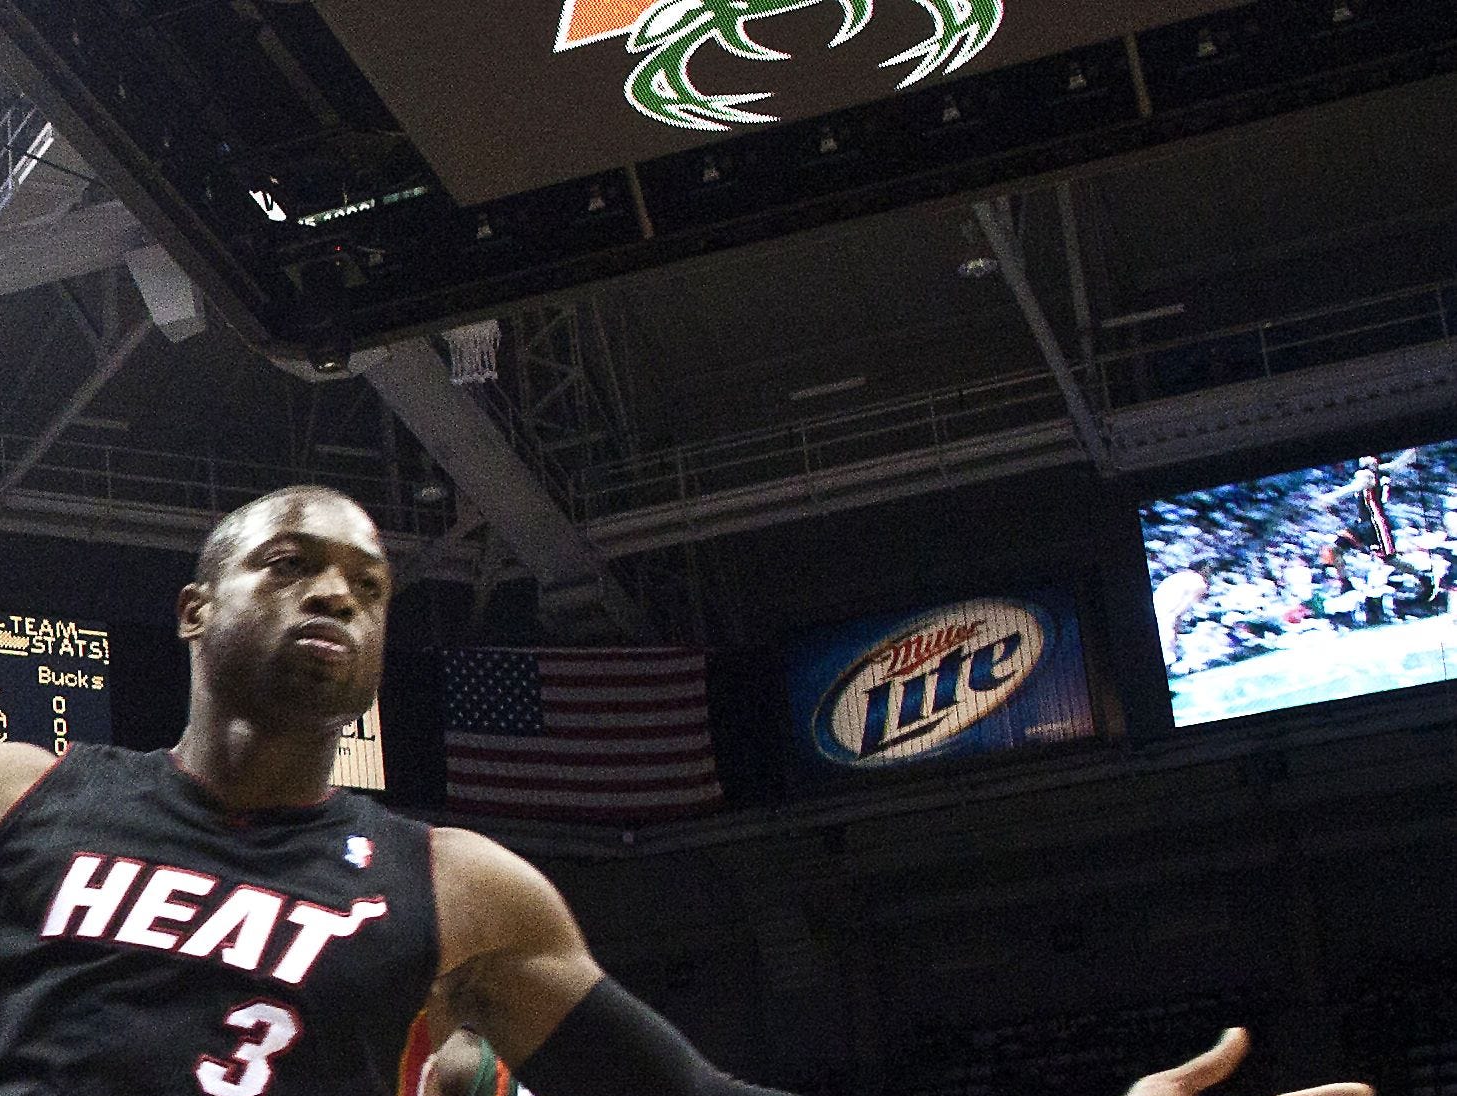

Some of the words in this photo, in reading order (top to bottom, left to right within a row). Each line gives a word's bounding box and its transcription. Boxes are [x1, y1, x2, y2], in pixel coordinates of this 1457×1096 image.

[9, 615, 78, 640] TEAM
[30, 636, 110, 665] STATS!
[38, 666, 104, 690] Bucks
[53, 696, 66, 714] 0
[54, 718, 68, 736] 0
[40, 849, 389, 987] HEAT
